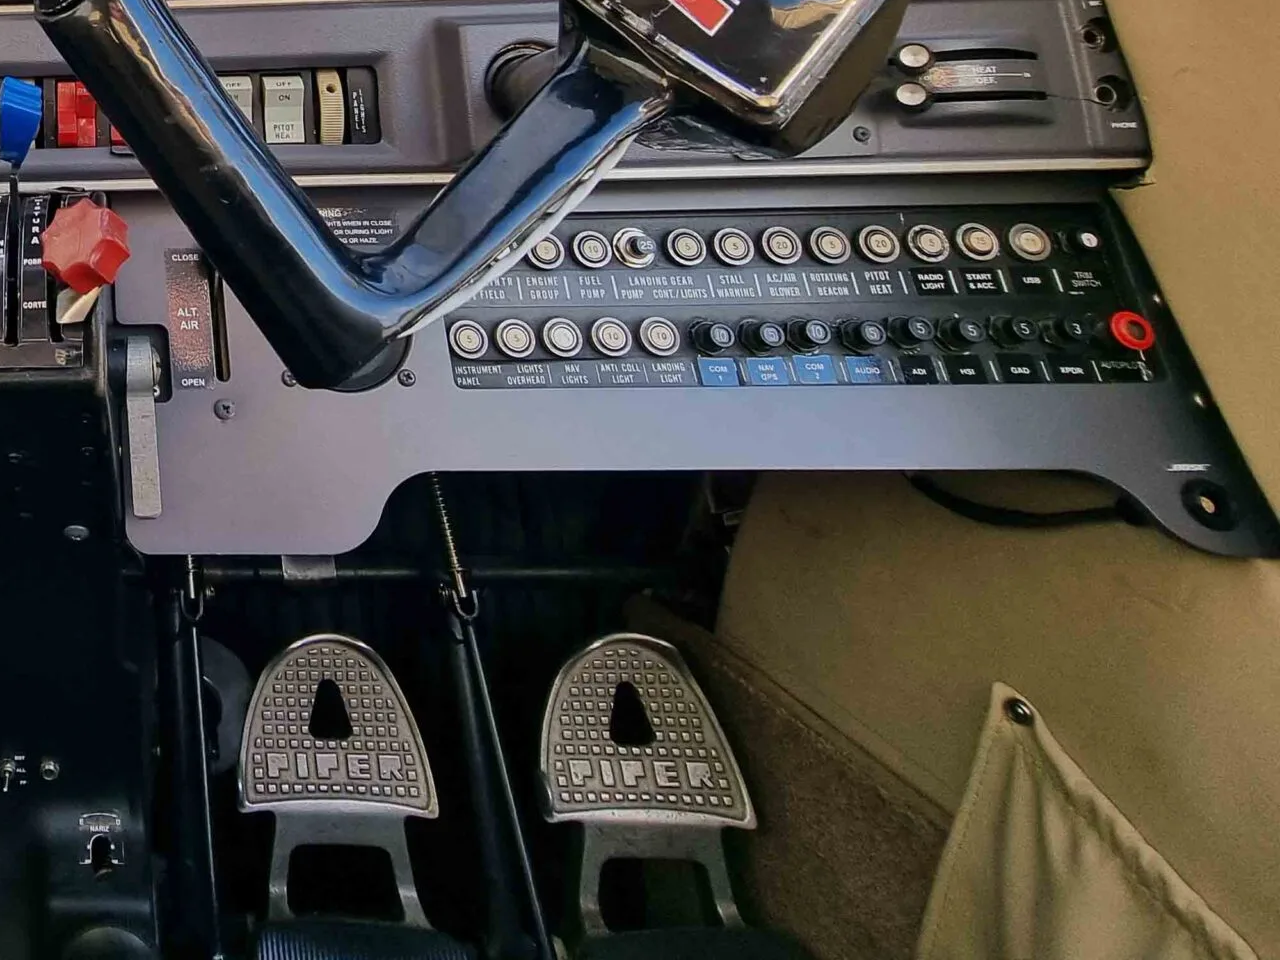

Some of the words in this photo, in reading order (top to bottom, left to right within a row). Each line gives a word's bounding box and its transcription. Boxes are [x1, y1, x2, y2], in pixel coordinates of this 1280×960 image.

[172, 253, 199, 261] CLOSE
[526, 276, 558, 286] ENGINE
[580, 275, 602, 285] FUEL
[629, 276, 667, 286] LANDING
[670, 275, 694, 285] GEAR
[720, 274, 744, 284] STALL
[811, 272, 848, 282] ROTATING
[865, 271, 889, 281] PITOT
[918, 273, 943, 282] RADIO
[966, 273, 992, 281] START
[531, 289, 559, 299] GROUP
[581, 288, 605, 298] PUMP
[621, 289, 644, 298] PUMP
[717, 287, 754, 298] WARNING
[818, 286, 848, 296] BEACON
[870, 284, 892, 294] HEAT
[178, 308, 199, 318] ALT.
[180, 320, 199, 330] AIR
[455, 365, 502, 375] INSTRUMENT
[517, 364, 543, 374] LIGHTS
[565, 364, 580, 373] NAV
[600, 363, 618, 373] ANTI
[621, 363, 641, 373] COLL
[652, 363, 685, 372] LANDING
[855, 367, 880, 375] AUDIO
[182, 378, 205, 387] OPEN
[458, 377, 480, 386] PANEL
[507, 375, 545, 385] OVERHEAD
[561, 375, 588, 384] LIGHTS
[612, 374, 634, 383] LIGHT
[660, 373, 682, 383] LIGHT
[267, 754, 404, 780] PIPER
[569, 759, 713, 788] PIPER
